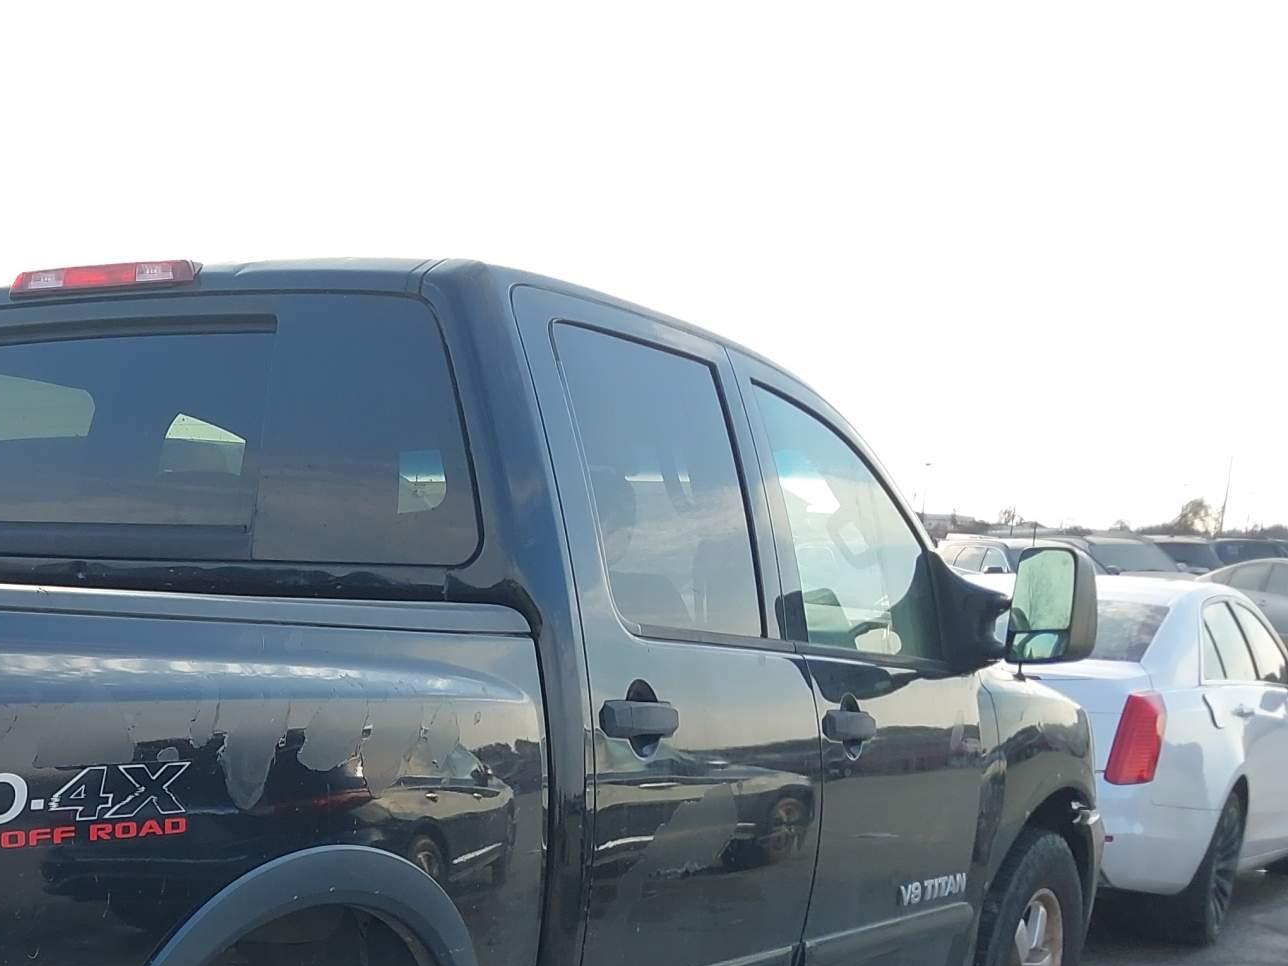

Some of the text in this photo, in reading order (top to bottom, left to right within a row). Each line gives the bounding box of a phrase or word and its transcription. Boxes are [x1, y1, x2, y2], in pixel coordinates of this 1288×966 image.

[0, 817, 188, 849] OFF ROAD
[899, 872, 967, 906] V8 TITAN
